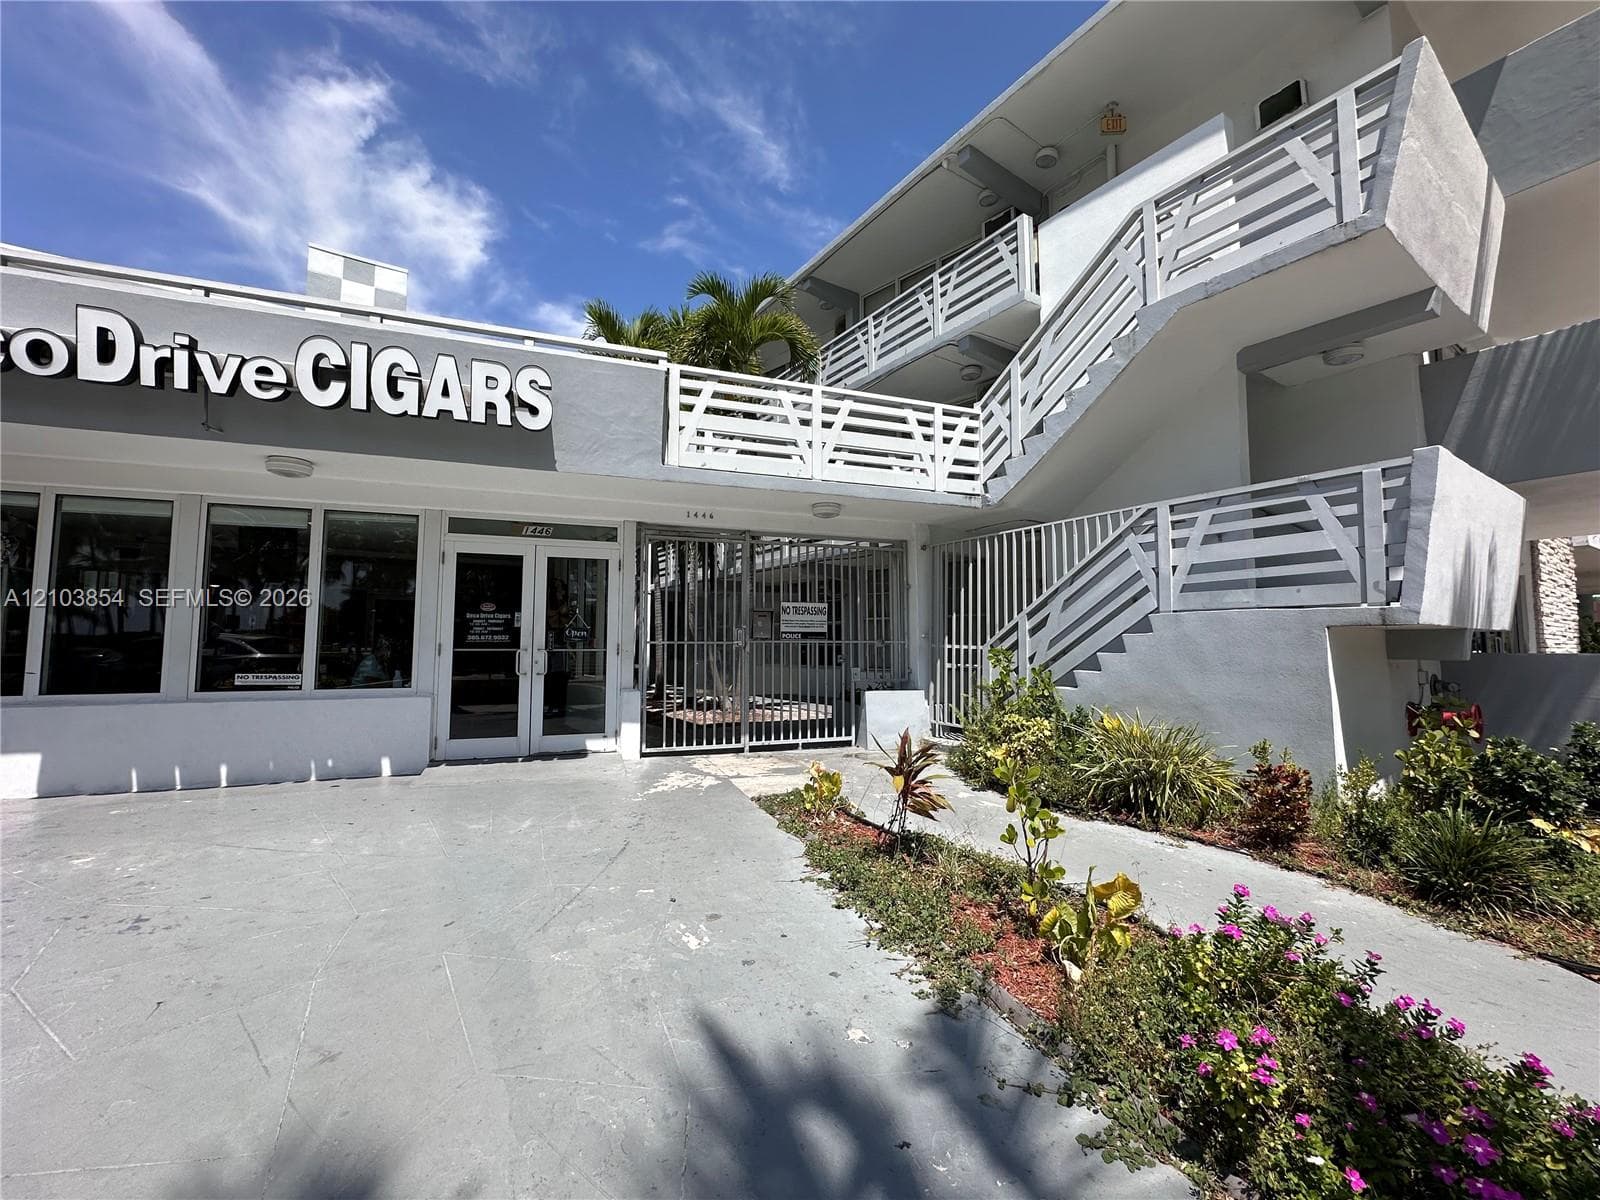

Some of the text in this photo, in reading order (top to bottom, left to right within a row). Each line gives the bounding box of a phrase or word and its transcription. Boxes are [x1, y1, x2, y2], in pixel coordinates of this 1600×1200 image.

[1106, 118, 1122, 130] EXIT
[294, 334, 553, 431] CIGARS
[686, 510, 715, 520] 1446
[523, 526, 552, 537] 1446
[782, 606, 826, 616] NO TRESPASSING
[565, 628, 587, 638] Open
